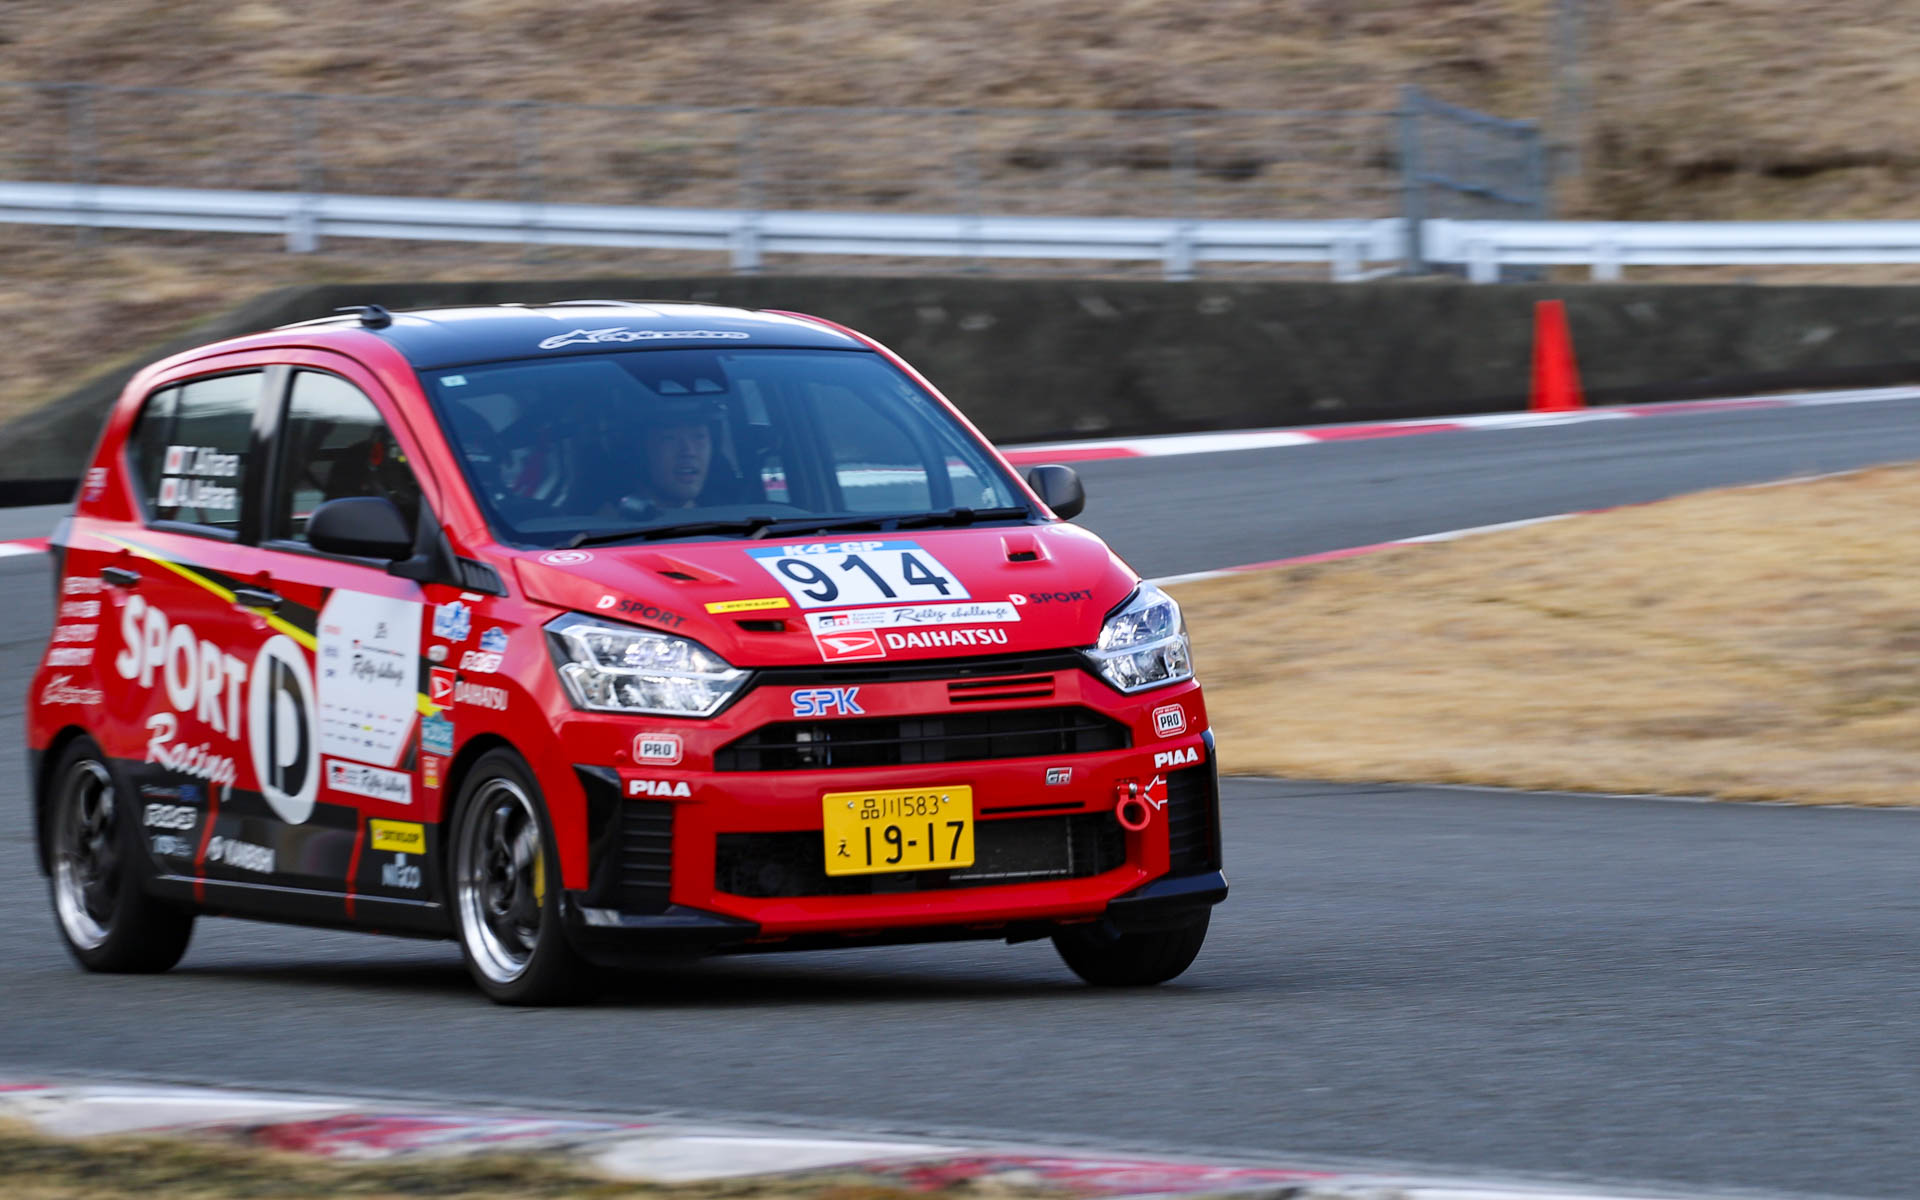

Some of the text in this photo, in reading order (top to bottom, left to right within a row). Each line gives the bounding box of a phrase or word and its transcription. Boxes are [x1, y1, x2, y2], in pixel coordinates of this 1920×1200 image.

[783, 541, 884, 557] K4-GP
[777, 553, 950, 602] 914
[1008, 590, 1094, 606] D SPORT
[596, 595, 687, 628] D SPORT
[893, 608, 946, 622] Rally
[951, 606, 1008, 621] challenge
[885, 628, 1008, 650] DAIHATSU
[115, 594, 247, 741] SPORT
[792, 687, 865, 716] SPK
[1160, 713, 1180, 728] PRO
[145, 712, 237, 802] Racing
[643, 743, 672, 756] PRO
[1154, 747, 1199, 769] PIAA
[629, 780, 692, 798] PIAA
[865, 820, 965, 866] 19-17
